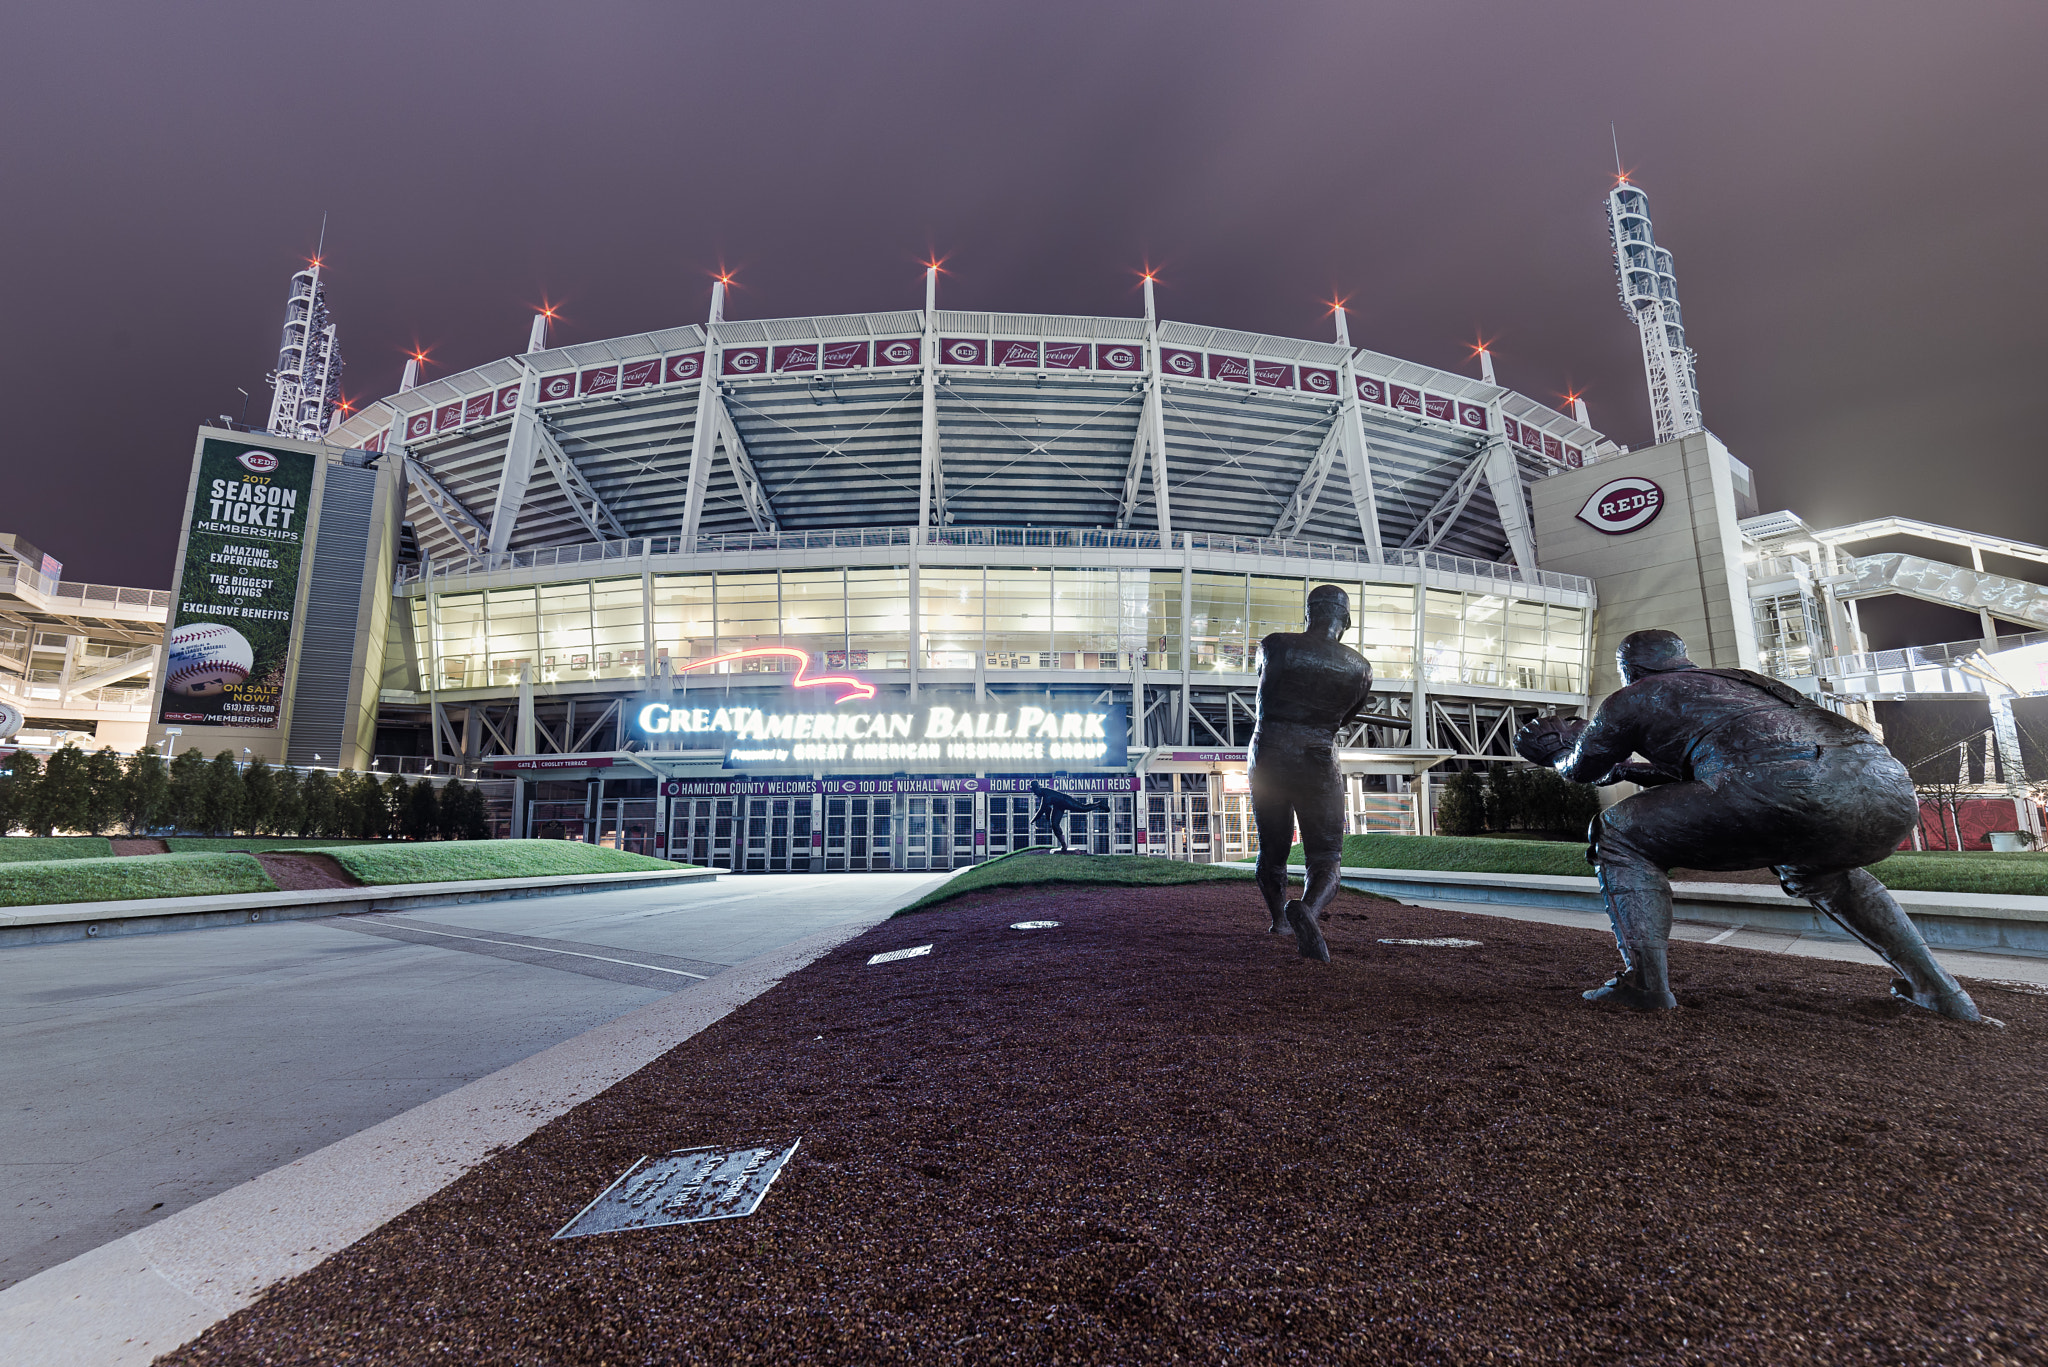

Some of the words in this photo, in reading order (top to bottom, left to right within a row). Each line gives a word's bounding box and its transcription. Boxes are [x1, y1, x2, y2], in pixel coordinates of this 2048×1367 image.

[249, 457, 277, 467] REDS
[242, 475, 271, 485] 2017
[211, 479, 297, 508] SEASON
[1601, 490, 1659, 517] REDS
[209, 499, 295, 529] TICKET
[198, 521, 298, 540] MEMBERSHIPS
[222, 544, 269, 558] AMAZING
[210, 553, 279, 569] EXPERIENCES
[209, 573, 229, 585] THE
[231, 576, 274, 589] BIGGEST
[217, 584, 263, 598] SAVINGS
[182, 602, 240, 616] EXCLUSIVE
[241, 607, 290, 621] BENEFITS
[223, 684, 243, 692] ON
[246, 685, 279, 694] SALE
[233, 693, 270, 703] NOW!
[223, 702, 242, 712] (513)
[242, 704, 275, 713] 765-7500
[638, 703, 752, 733] GREAT
[736, 708, 914, 741] AMERICAN
[924, 706, 1013, 738] BALL
[1014, 705, 1108, 738] PARK
[793, 743, 848, 761] GREAT
[852, 743, 941, 760] AMERICAN
[946, 742, 1044, 759] INSURANCE
[1049, 742, 1108, 759] GROUP
[1214, 753, 1221, 761] A
[531, 760, 538, 769] A
[681, 782, 727, 795] HAMILTON
[729, 781, 765, 794] COUNTY
[767, 780, 817, 794] WELCOMES
[821, 780, 840, 793] YOU
[859, 781, 875, 793] 100
[877, 780, 894, 793] JOE
[896, 780, 939, 792] NUXHALL
[941, 779, 962, 792] WAY
[990, 779, 1016, 791] HOME
[1053, 779, 1105, 791] CINCINNATI
[1107, 778, 1131, 790] REDS
[684, 1157, 726, 1185] Crosley
[718, 1167, 760, 1203] Legends
[667, 1185, 700, 1208] Field
